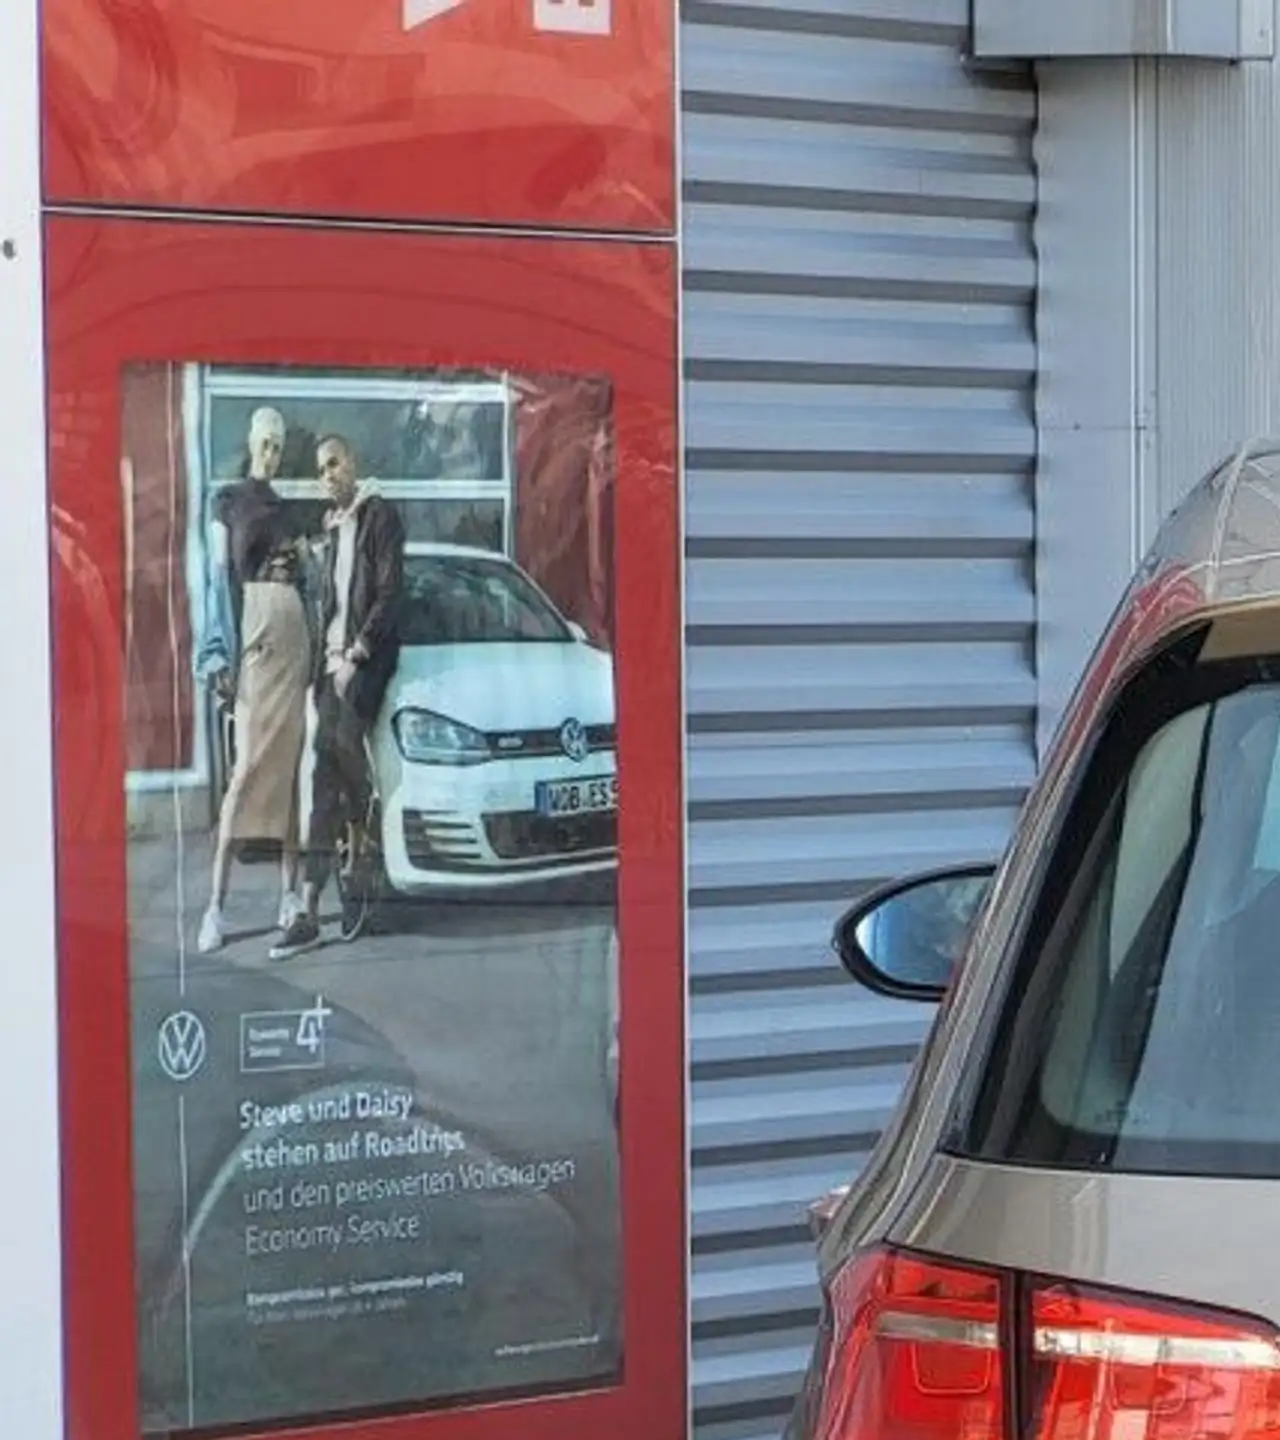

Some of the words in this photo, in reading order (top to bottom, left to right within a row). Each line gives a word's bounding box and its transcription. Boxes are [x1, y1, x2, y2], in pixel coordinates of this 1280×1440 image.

[239, 1099, 303, 1130] Steve
[308, 1093, 350, 1121] und
[356, 1087, 413, 1120] Daisy
[241, 1137, 319, 1170] stehen
[323, 1130, 360, 1162] auf
[365, 1125, 466, 1159] Roadtrips
[243, 1184, 284, 1214] und
[290, 1178, 330, 1208] den
[335, 1168, 455, 1209] preiswerten
[458, 1158, 576, 1191] Volkswagen
[245, 1223, 344, 1257] Economy
[347, 1209, 421, 1243] Service
